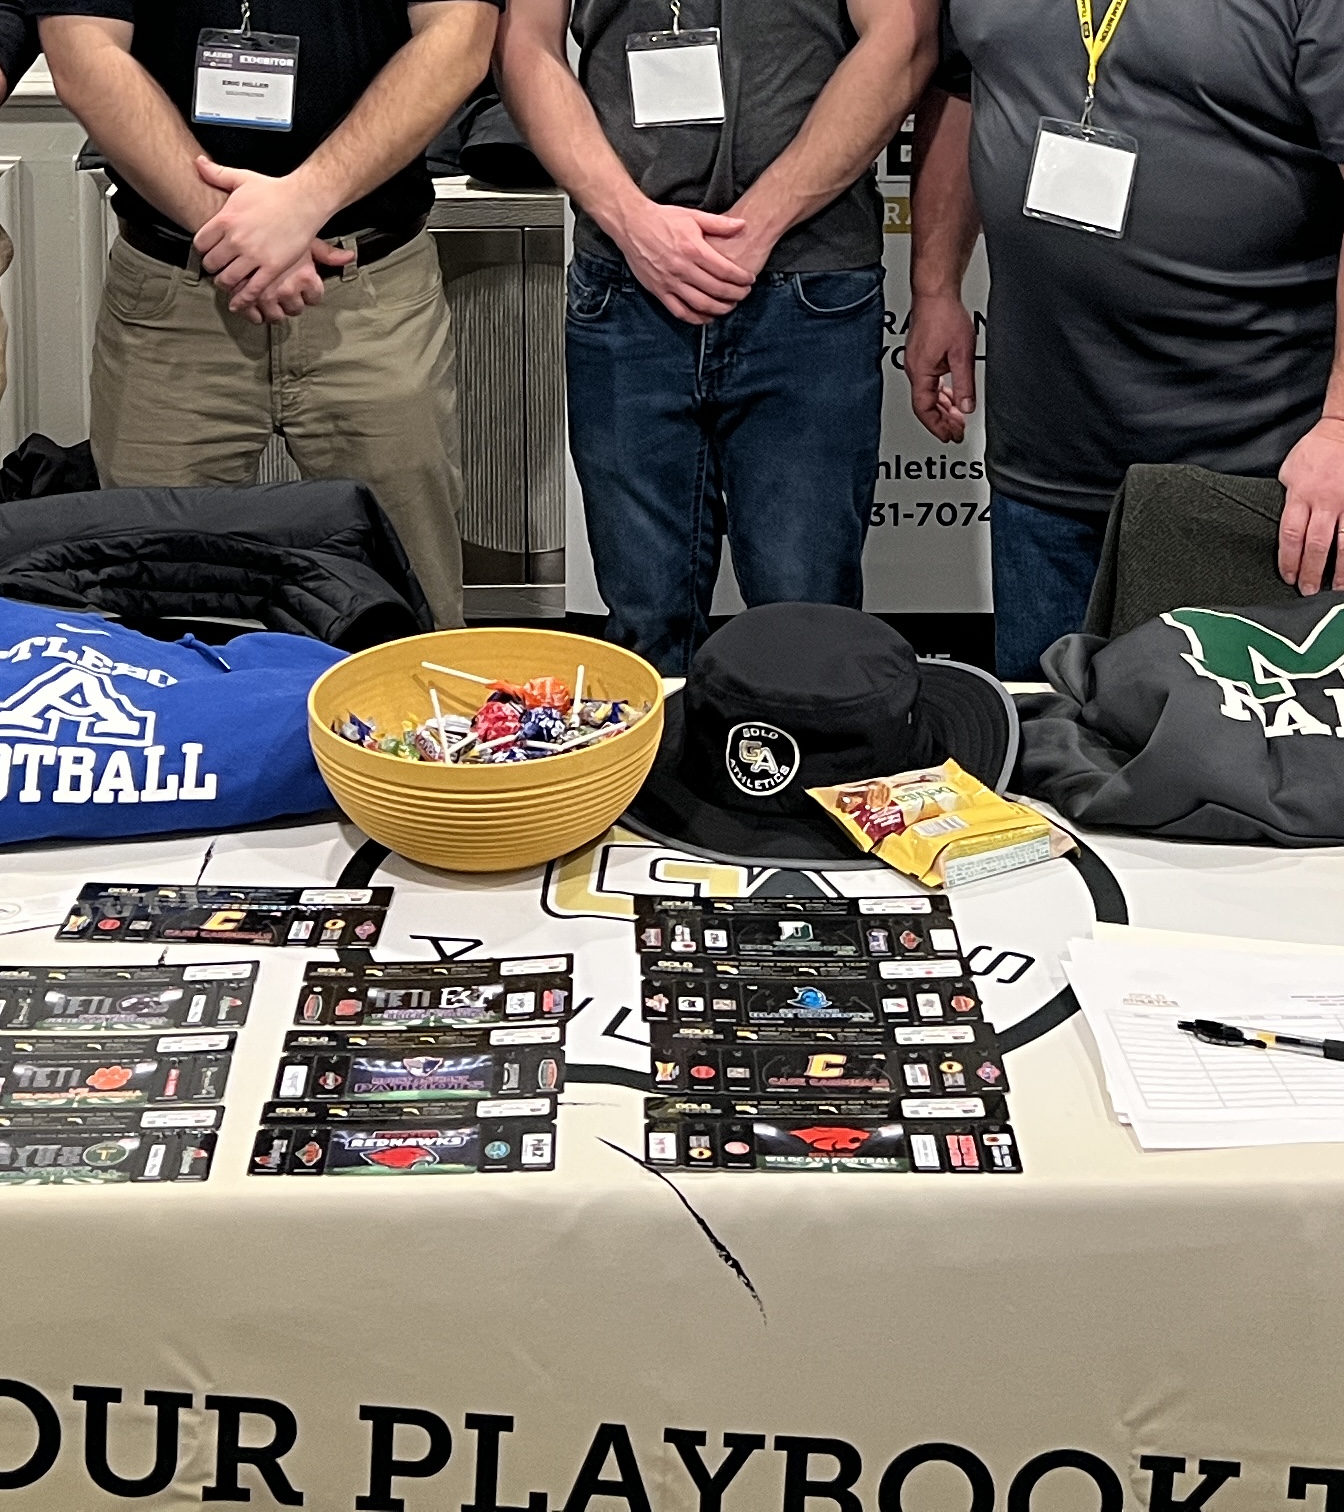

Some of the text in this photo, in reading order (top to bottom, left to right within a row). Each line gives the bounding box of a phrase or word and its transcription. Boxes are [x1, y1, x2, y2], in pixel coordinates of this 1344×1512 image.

[239, 55, 295, 68] EXHIBITOR
[742, 726, 779, 741] GOLD
[739, 739, 780, 777] GA
[728, 758, 791, 791] ATHLETICS
[804, 1053, 848, 1078] C
[350, 1137, 463, 1148] REDHAWKS
[765, 1155, 898, 1165] WILDCATS FOOTBALL
[354, 1404, 1241, 1512] PLAYBOOK
